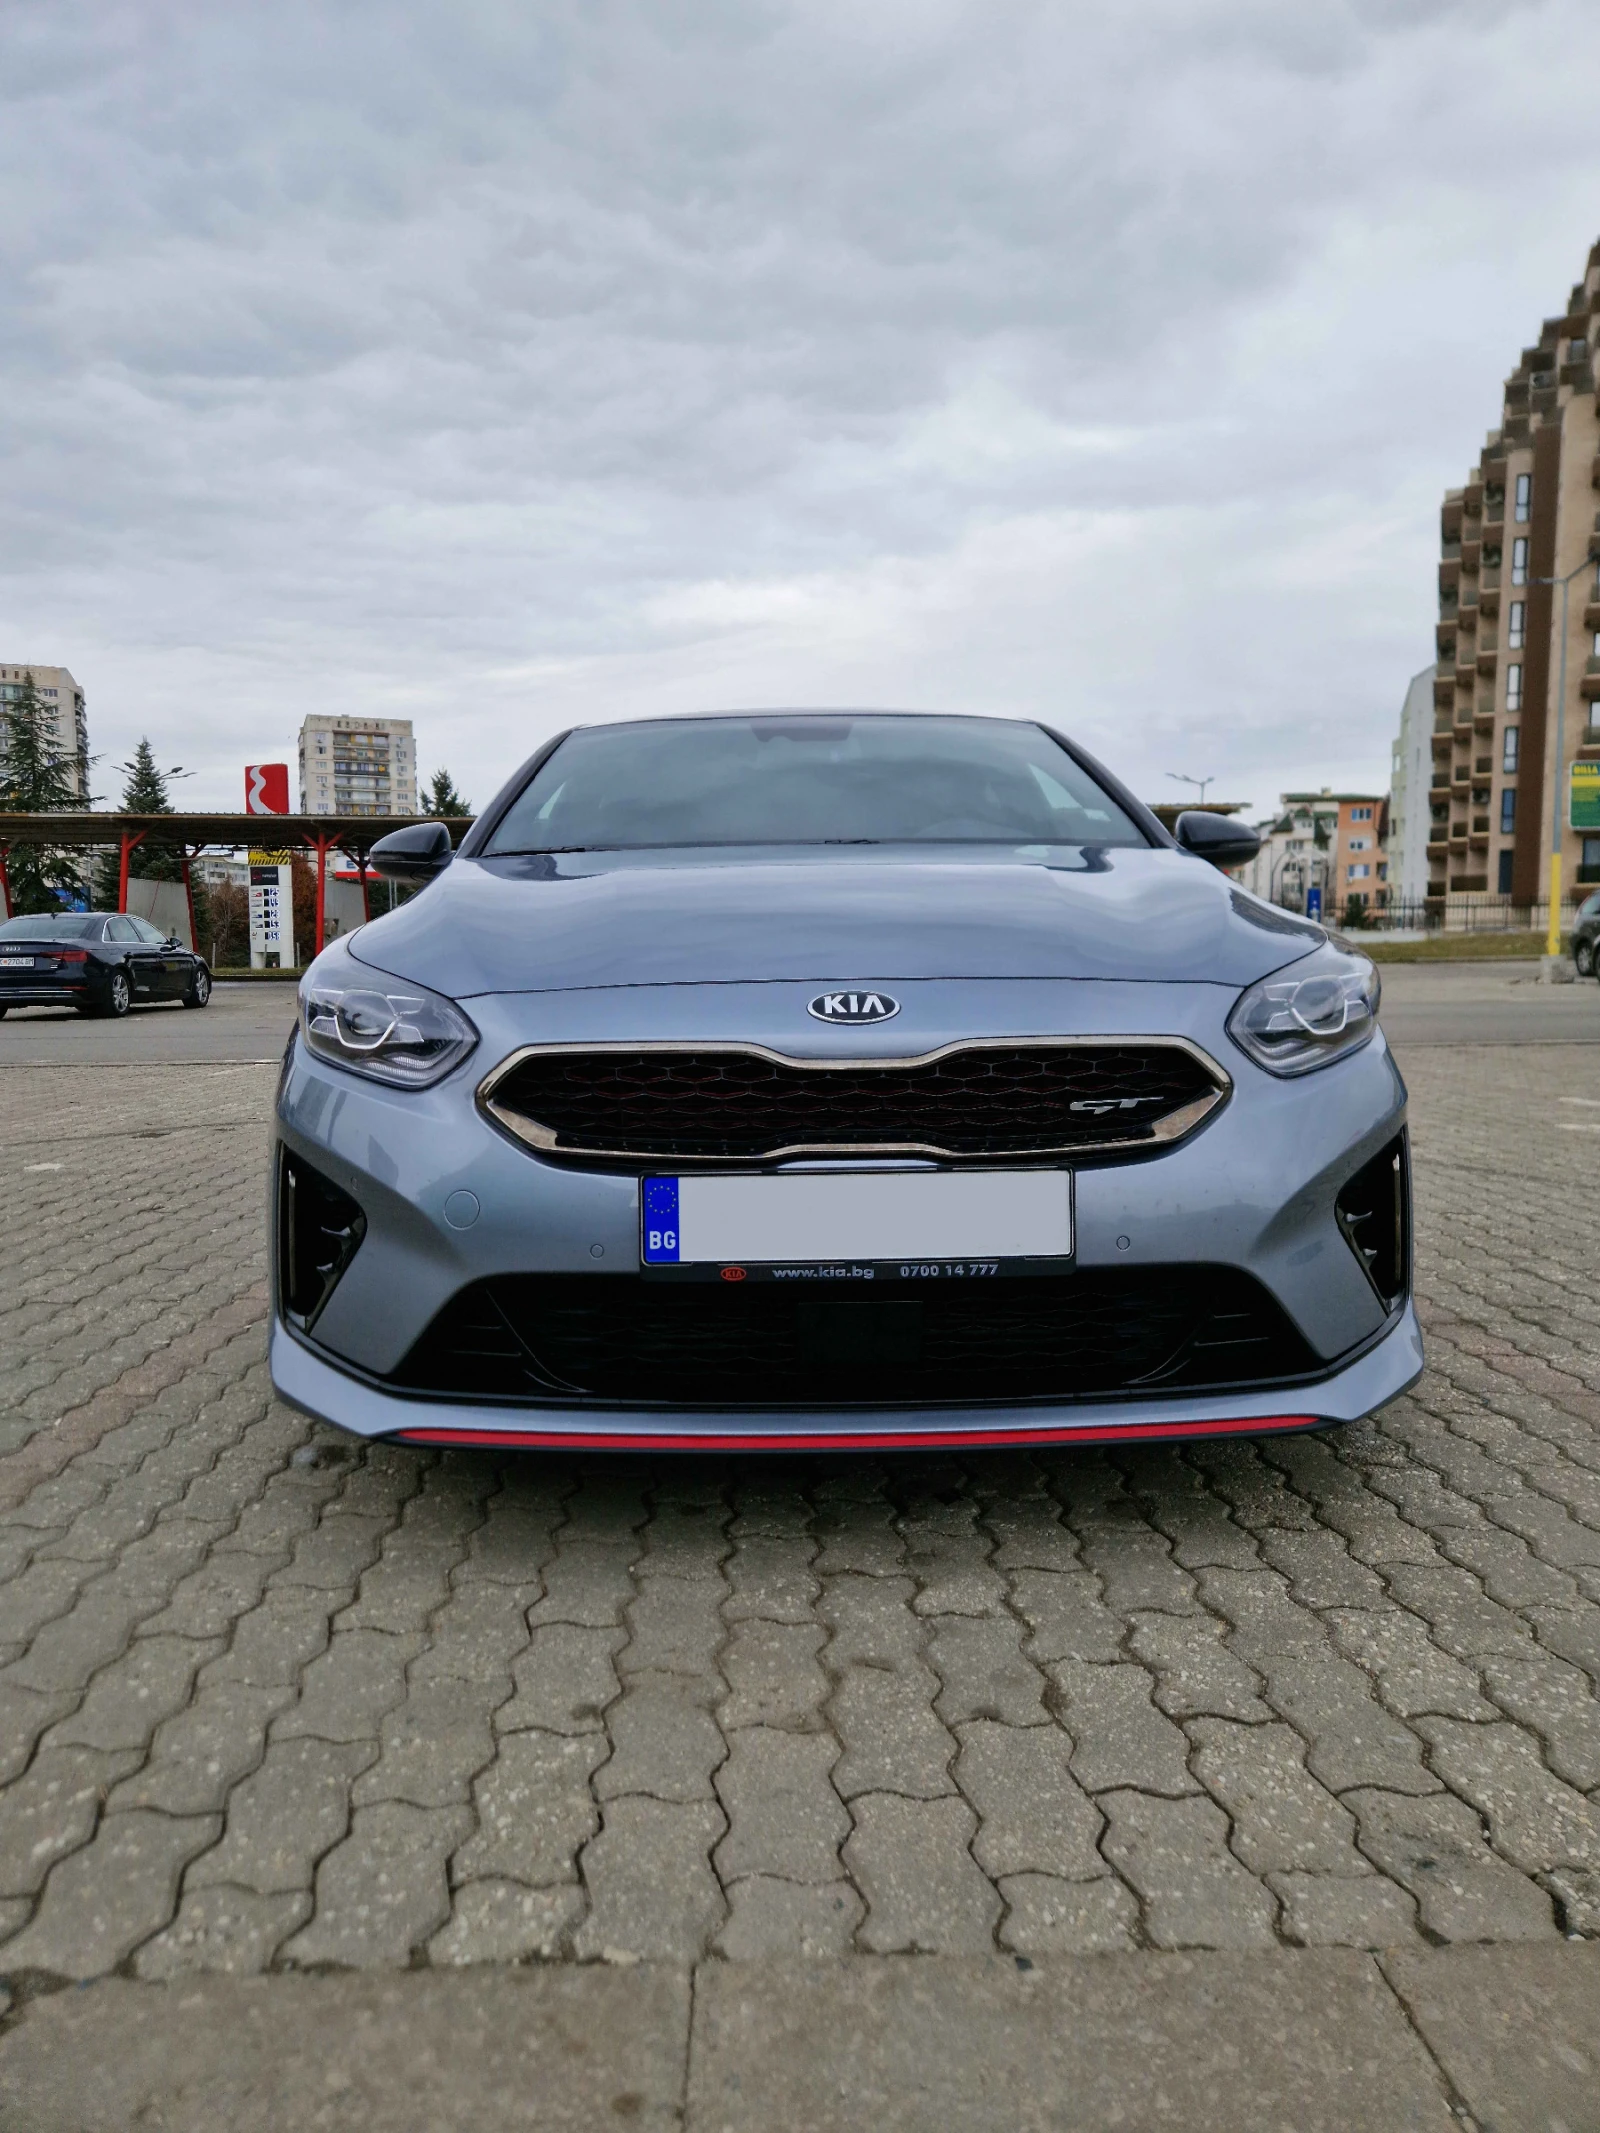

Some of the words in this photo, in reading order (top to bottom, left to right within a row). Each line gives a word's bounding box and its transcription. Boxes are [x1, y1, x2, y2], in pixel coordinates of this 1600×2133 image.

[823, 994, 886, 1014] KIA
[649, 1230, 677, 1250] BG
[724, 1269, 743, 1278] KIA
[772, 1264, 875, 1279] www.kia.bg
[900, 1265, 940, 1278] 0700
[945, 1264, 965, 1277] 14
[969, 1264, 999, 1276] 777
